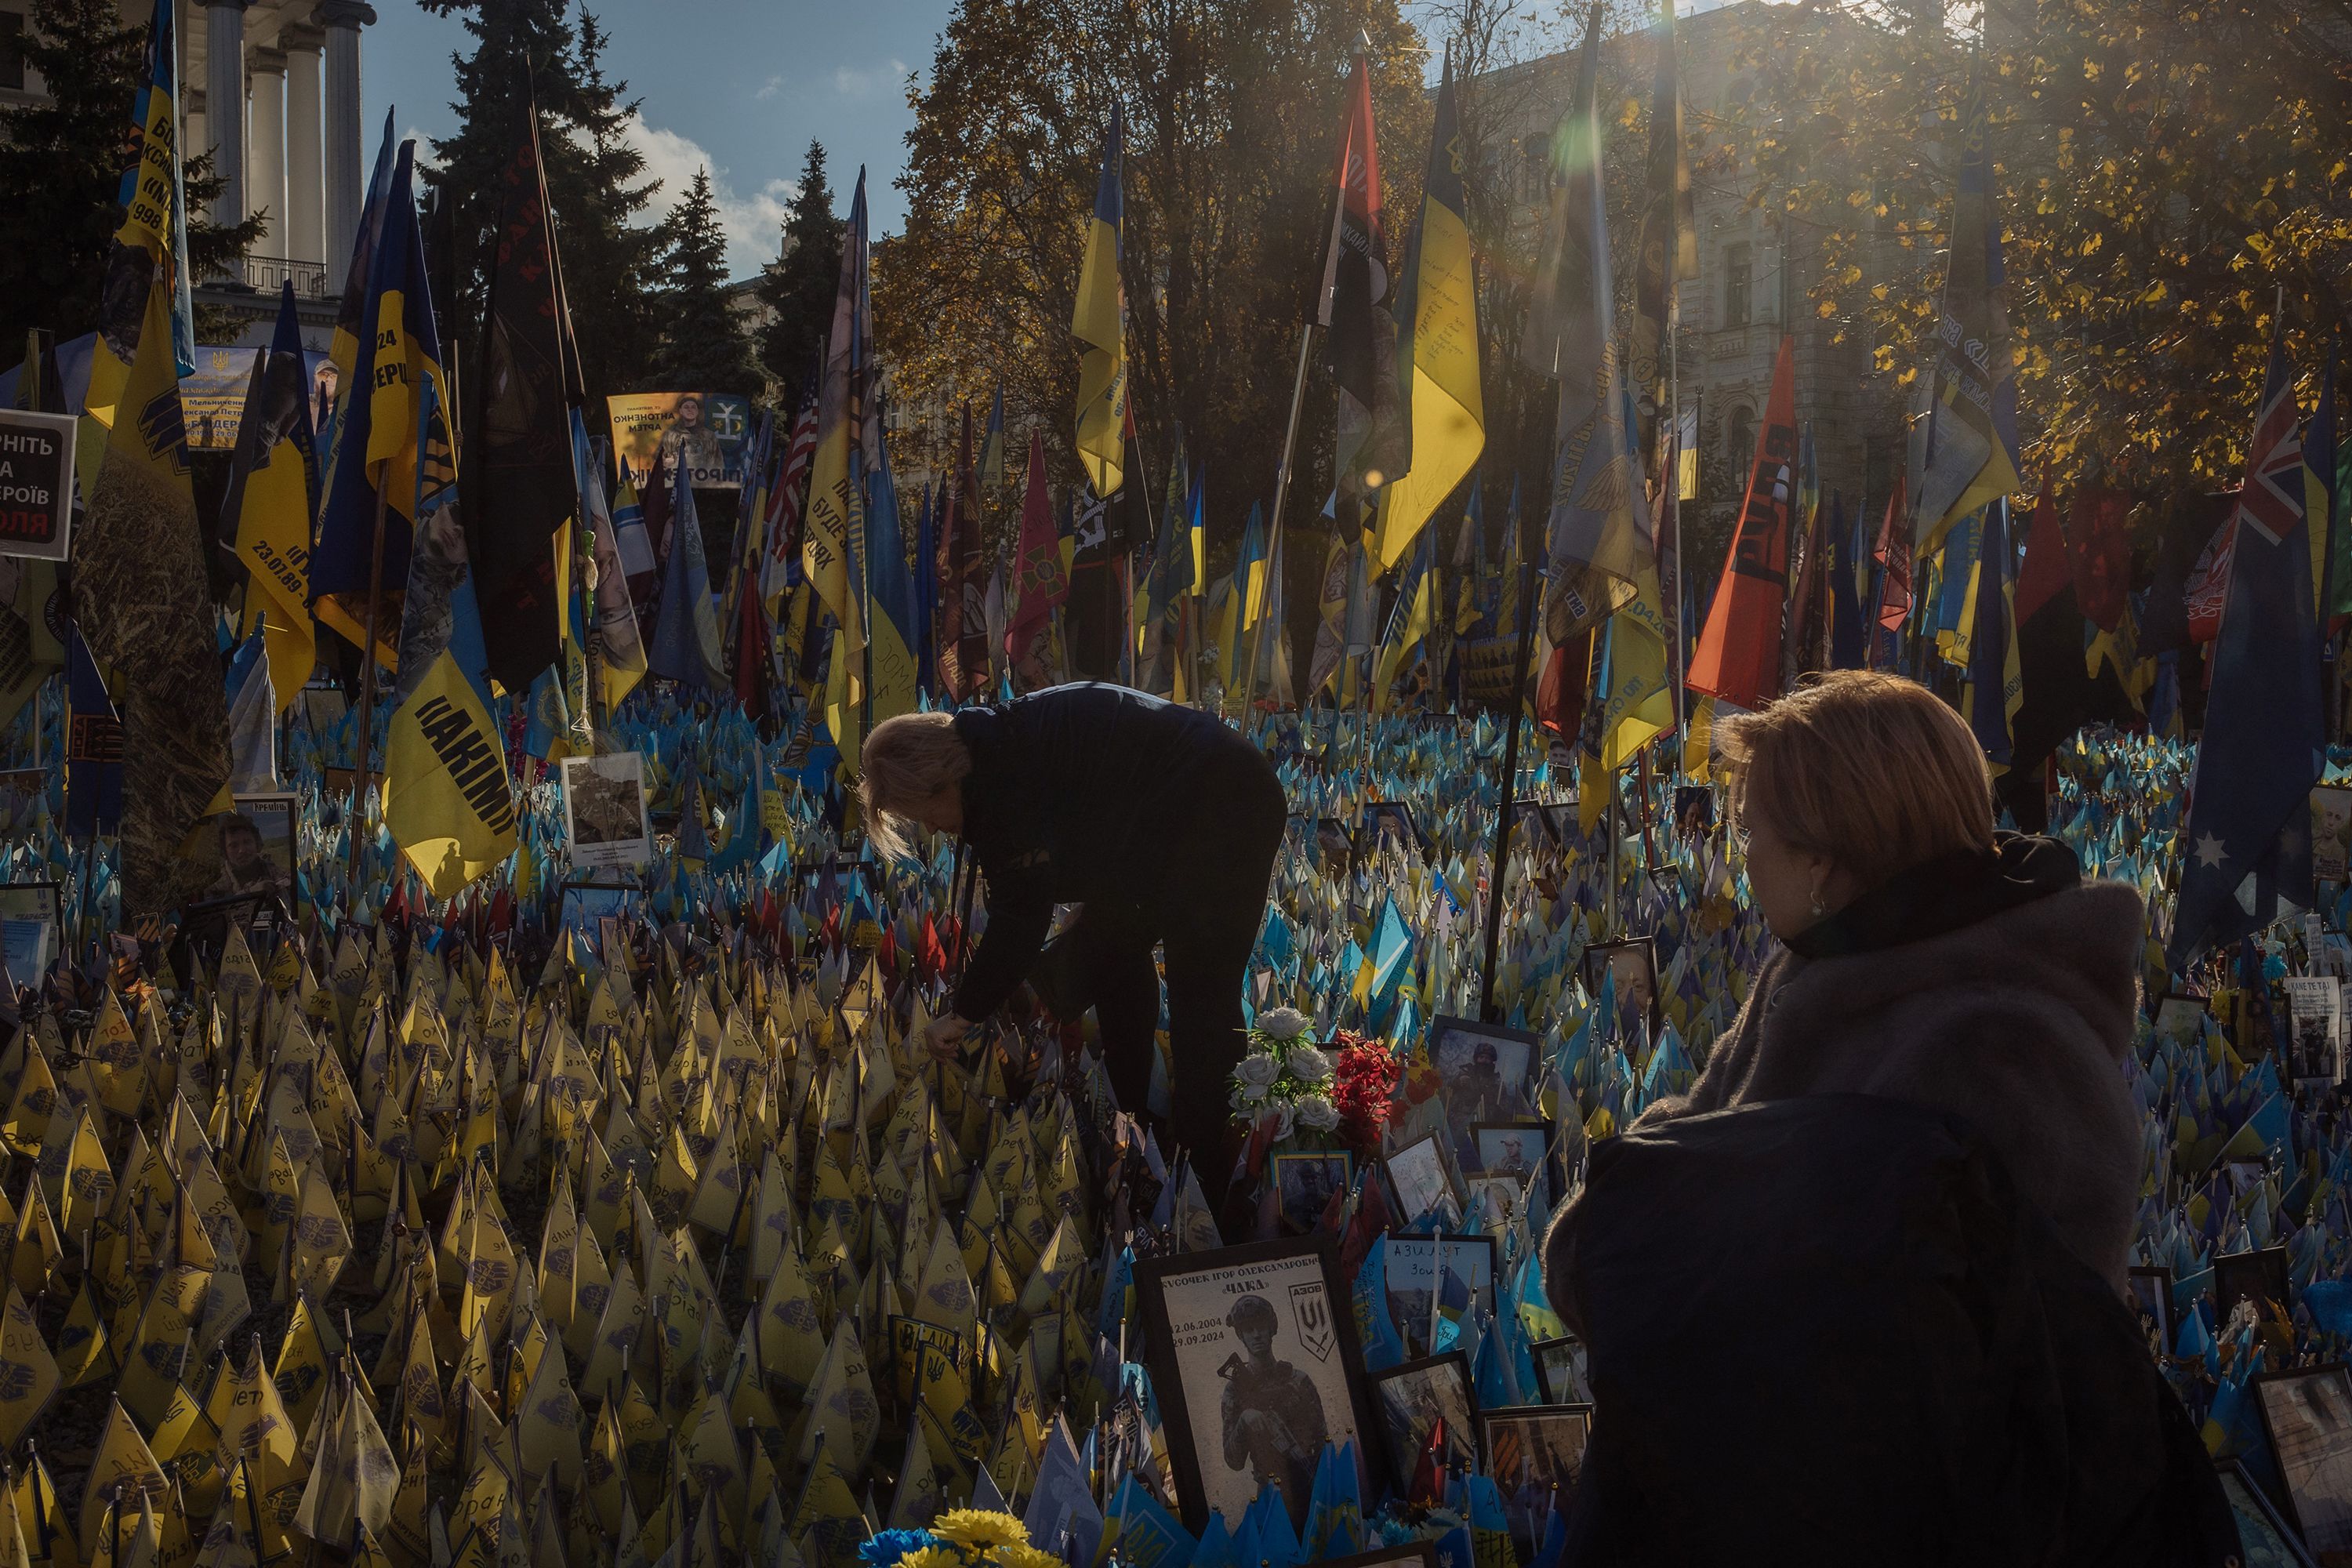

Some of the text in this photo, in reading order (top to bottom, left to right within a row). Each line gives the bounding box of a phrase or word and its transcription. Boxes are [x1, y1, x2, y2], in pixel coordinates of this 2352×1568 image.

[183, 408, 220, 417] ександр
[812, 496, 845, 539] БУДЕ
[415, 695, 515, 837] «АКІМ»
[1213, 1271, 1236, 1282] ІГОР
[1222, 1279, 1270, 1294] «ЧАКА»
[1293, 1285, 1323, 1297] АЗОВ
[1171, 1317, 1222, 1334] 2.06.2004
